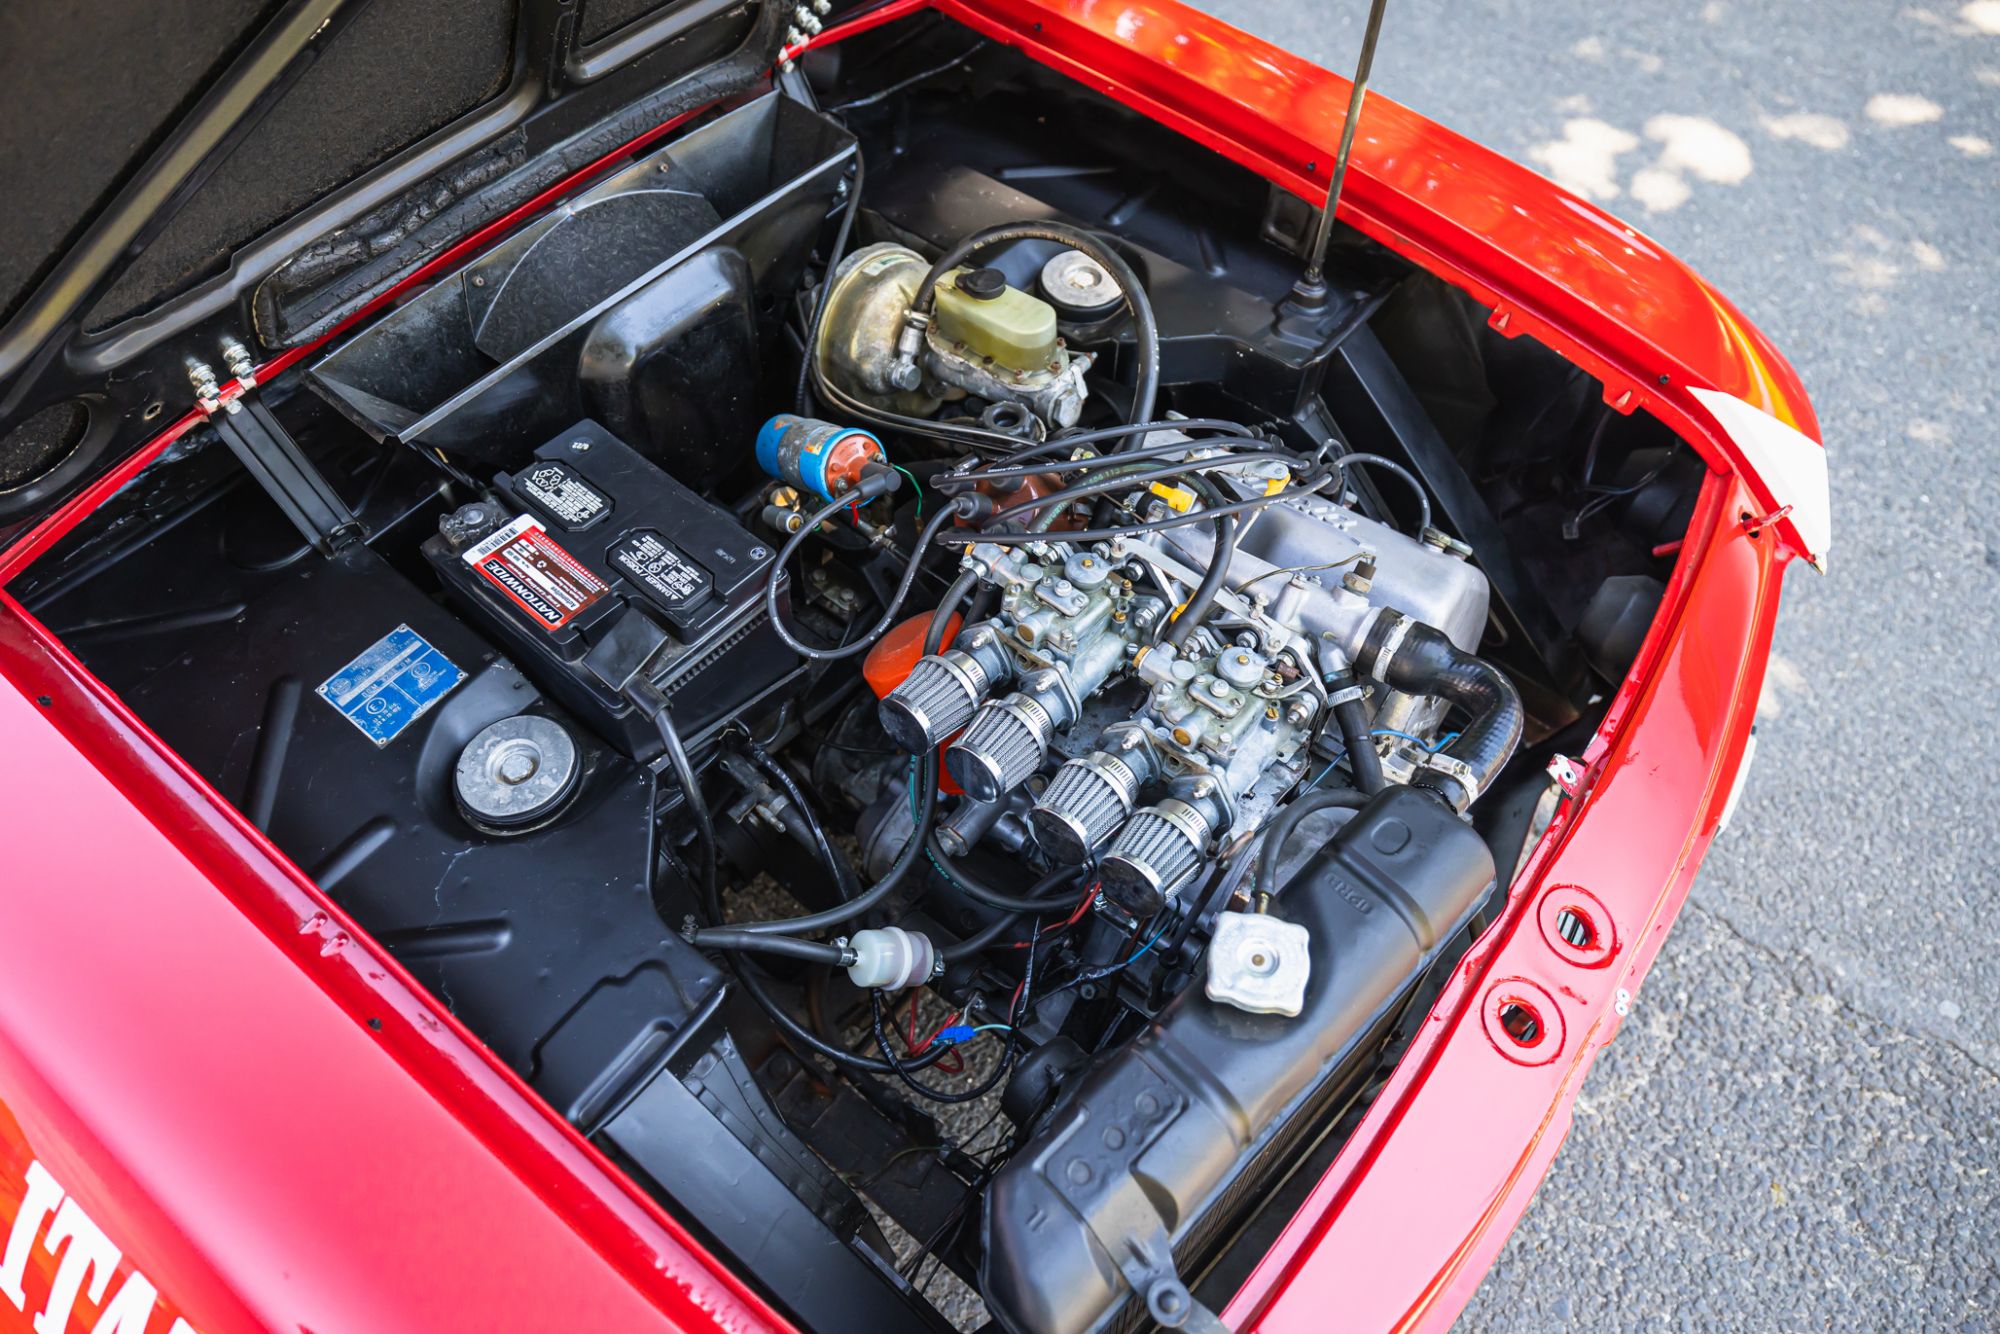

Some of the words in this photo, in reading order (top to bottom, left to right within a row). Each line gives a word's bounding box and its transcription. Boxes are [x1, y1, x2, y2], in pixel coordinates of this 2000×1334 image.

[507, 563, 526, 578] Power
[619, 555, 643, 574] POISON
[487, 563, 558, 619] NATIONWIDE
[645, 575, 672, 596] DANGER
[550, 586, 576, 608] Automotive
